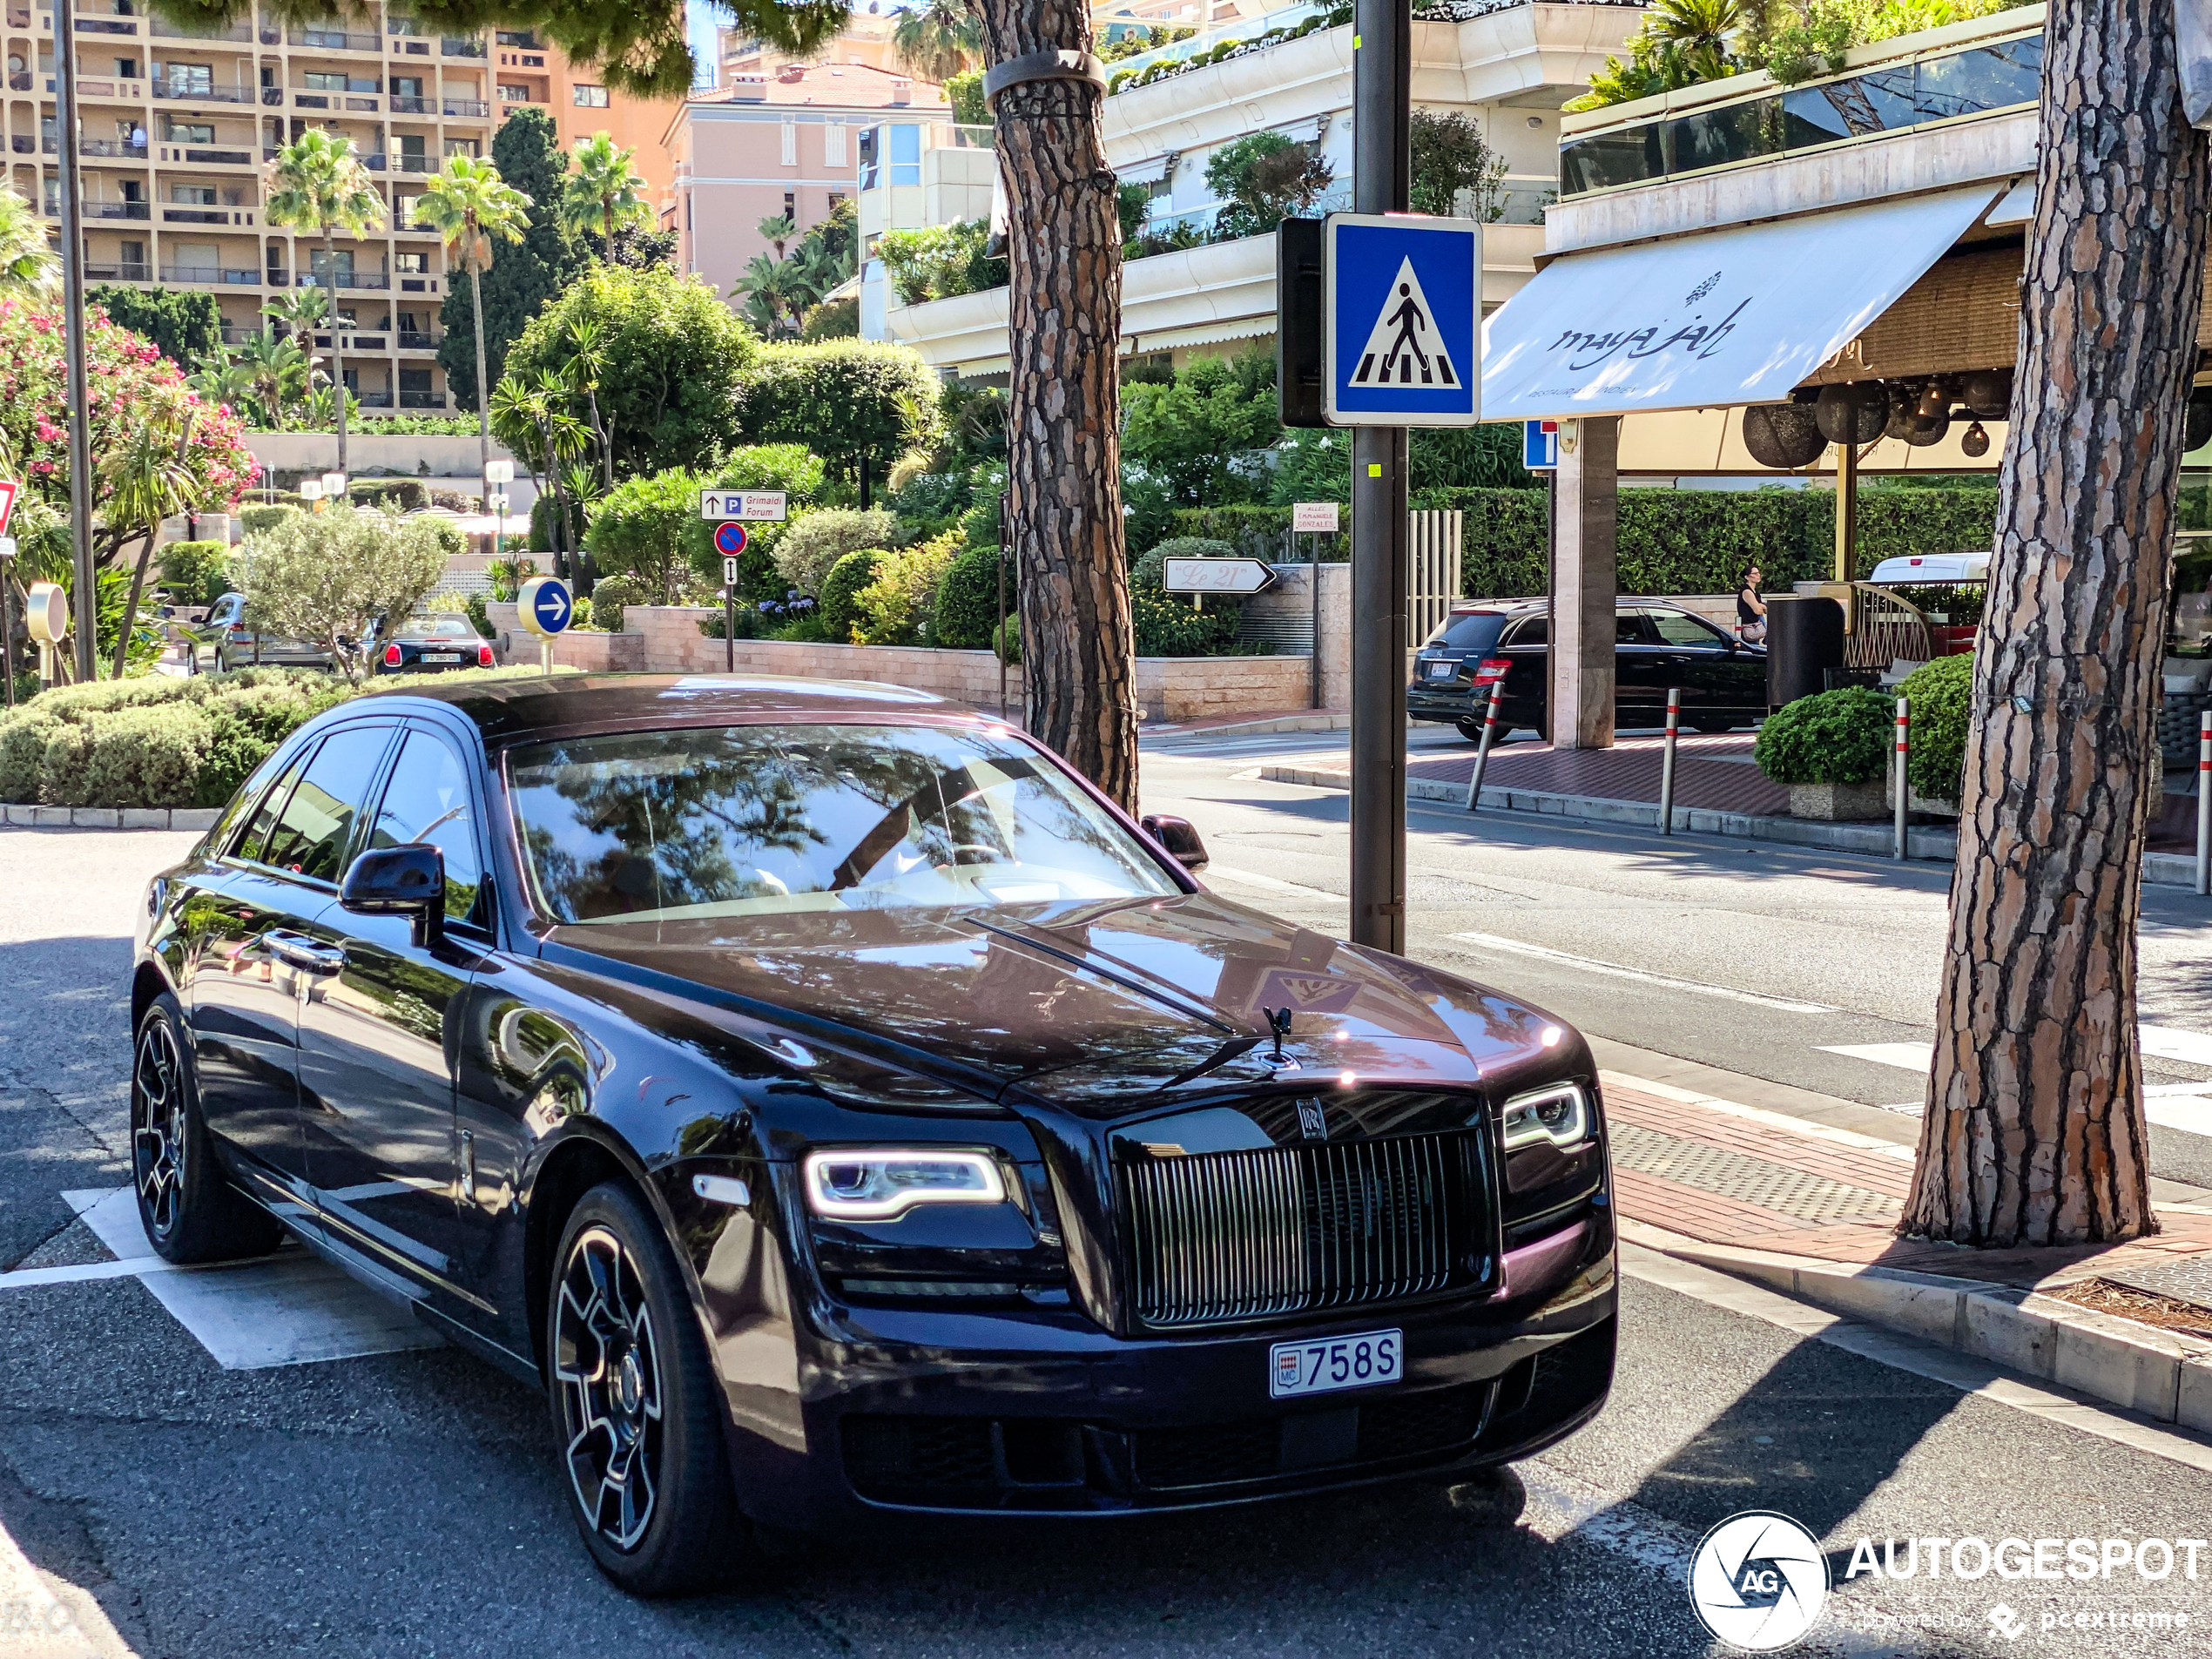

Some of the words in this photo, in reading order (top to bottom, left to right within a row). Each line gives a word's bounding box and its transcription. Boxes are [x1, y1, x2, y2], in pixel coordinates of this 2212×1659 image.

[746, 496, 782, 505] Grimaldi
[746, 508, 773, 516] Forum
[1306, 1339, 1395, 1386] 758S
[1281, 1370, 1297, 1382] MC
